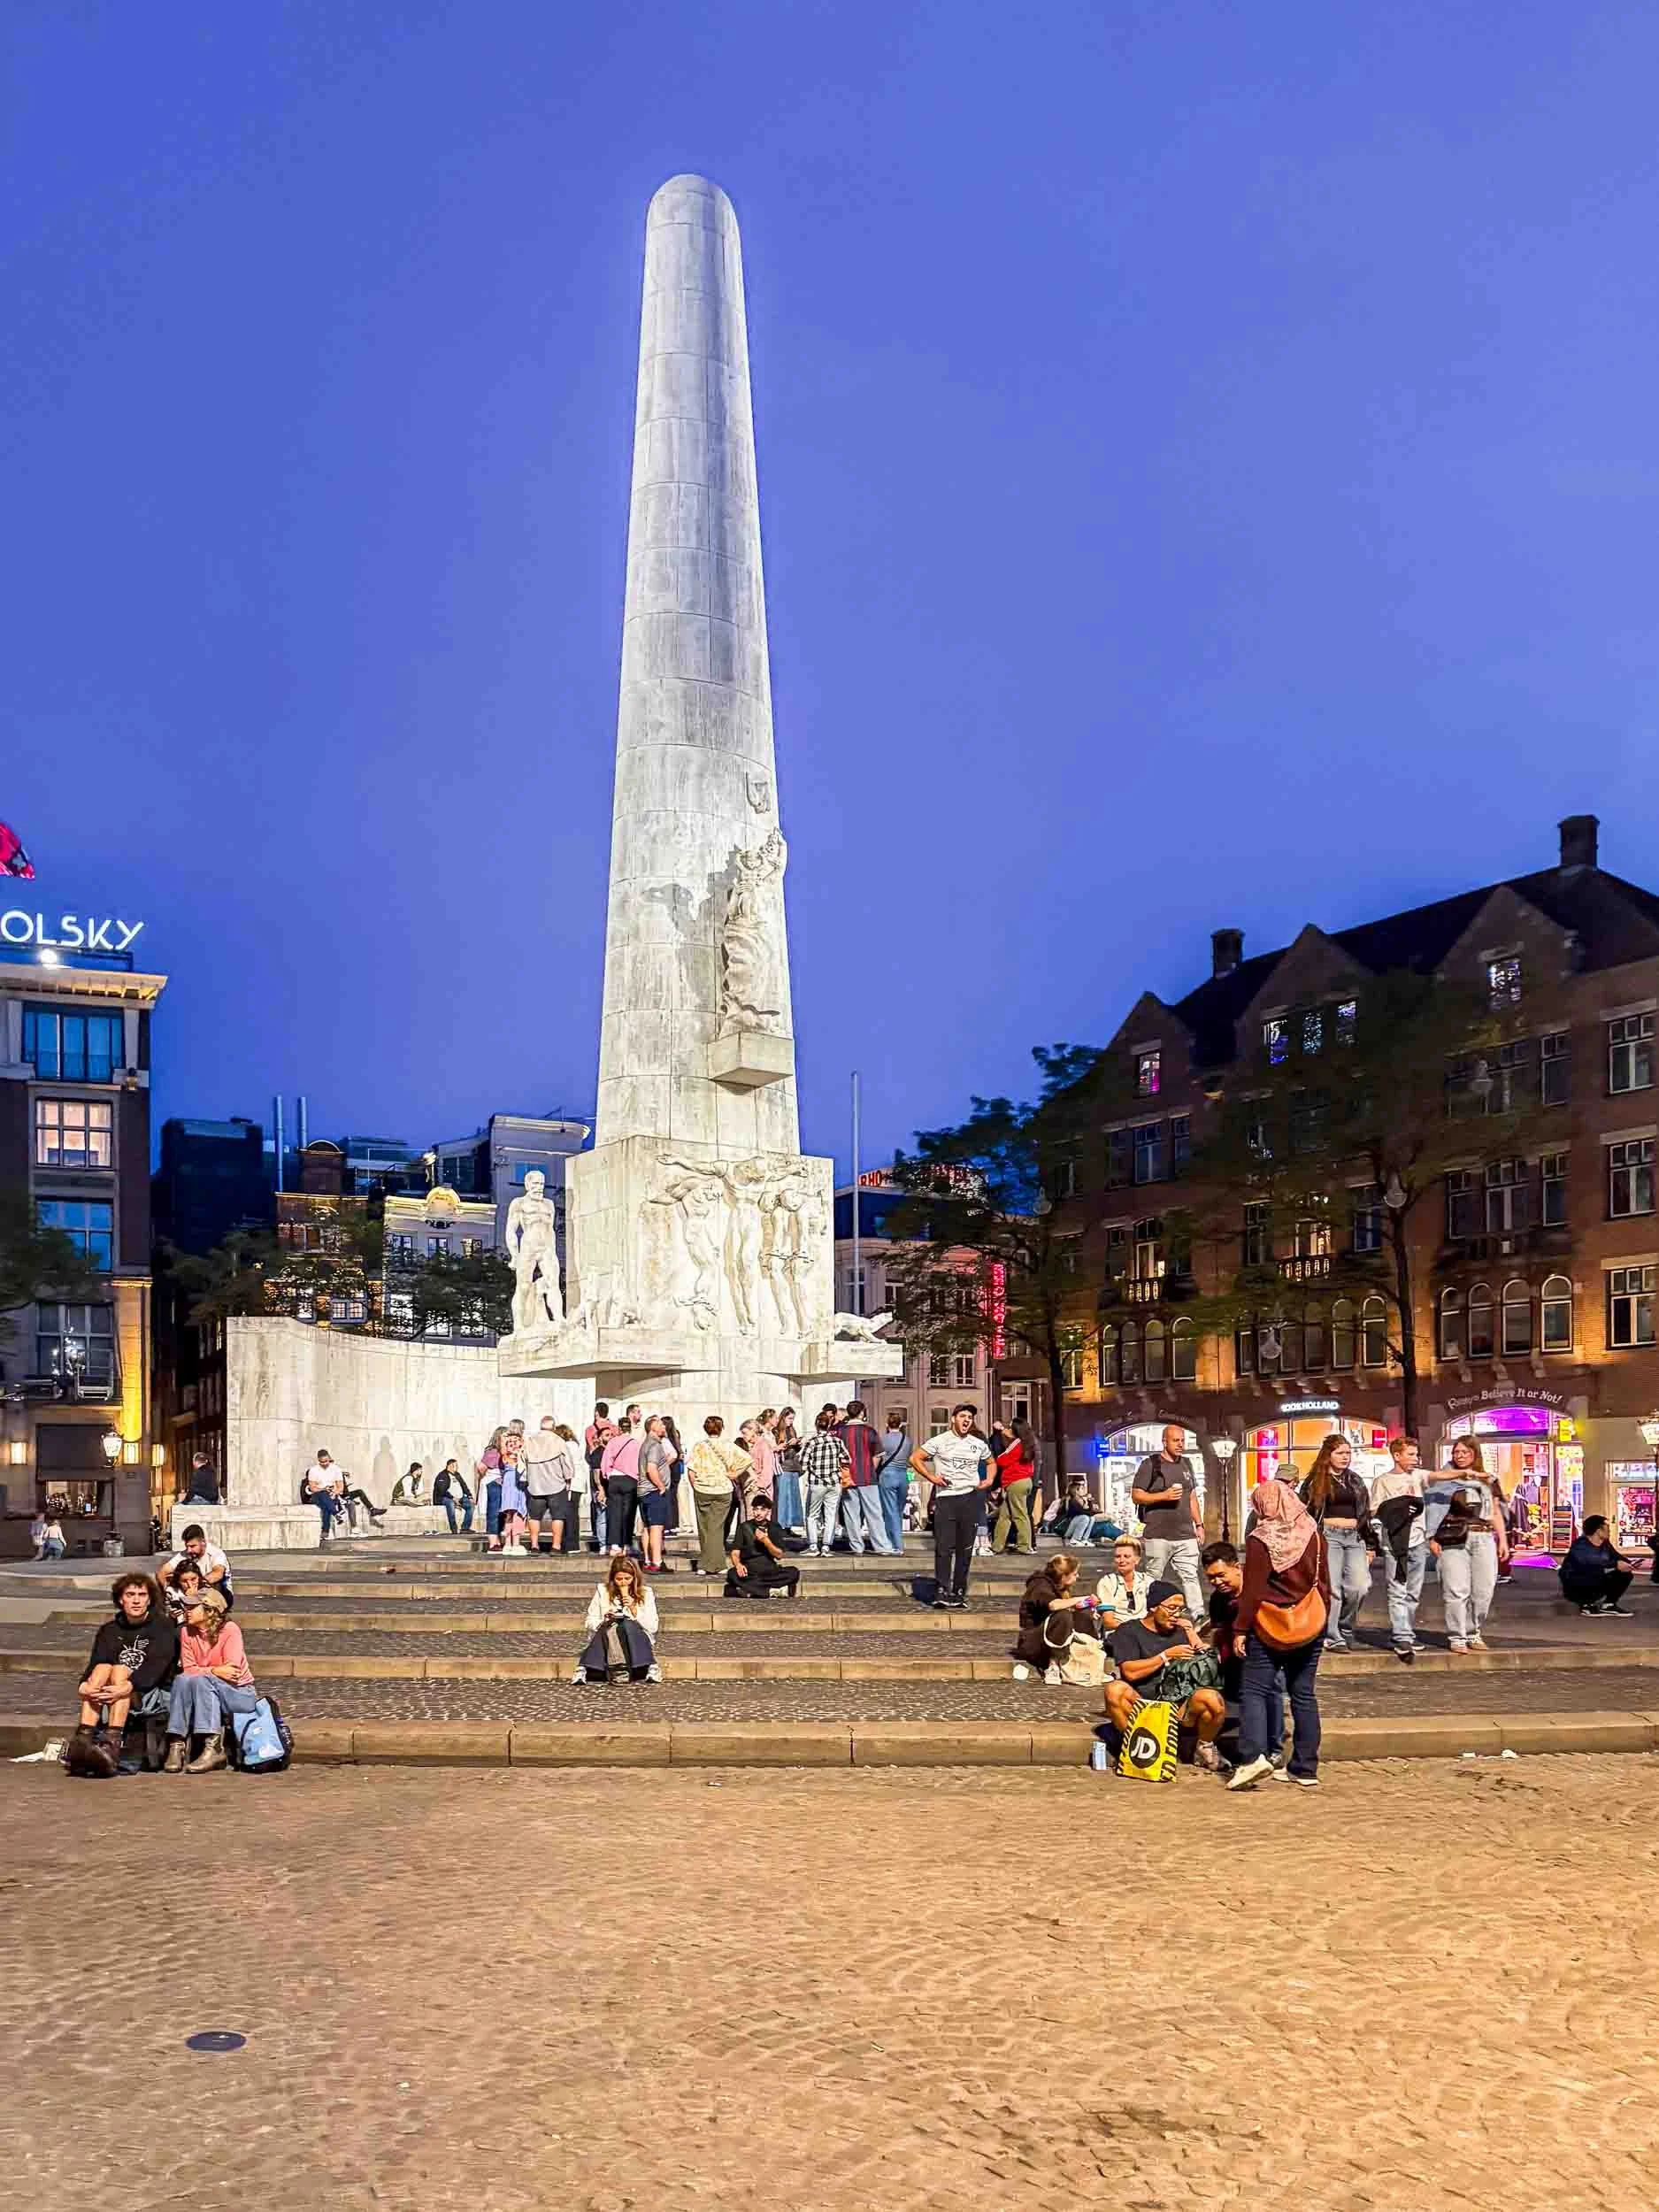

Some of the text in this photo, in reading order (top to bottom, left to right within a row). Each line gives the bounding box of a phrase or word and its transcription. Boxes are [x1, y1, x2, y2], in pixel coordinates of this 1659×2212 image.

[1, 910, 144, 949] OLSKY
[1516, 1387, 1525, 1397] It
[1540, 1391, 1563, 1404] Not!
[1130, 1736, 1156, 1759] JD
